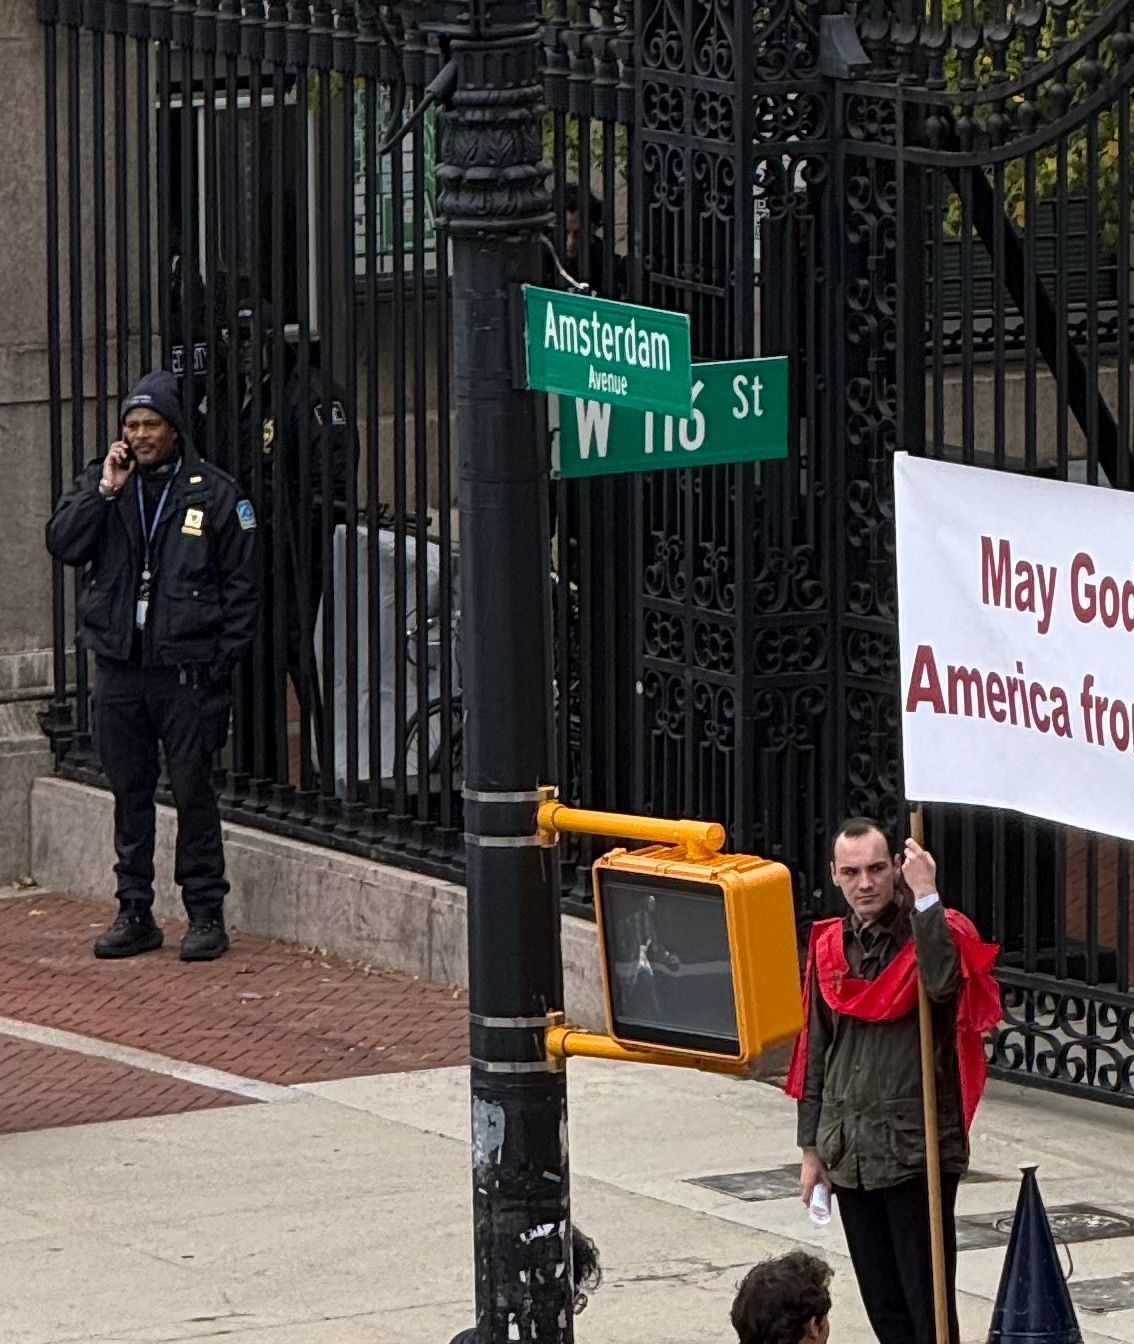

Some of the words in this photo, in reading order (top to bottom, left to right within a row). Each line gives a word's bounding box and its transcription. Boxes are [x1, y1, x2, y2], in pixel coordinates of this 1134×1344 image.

[544, 301, 671, 371] Amsterdam
[575, 397, 611, 460] W
[644, 380, 706, 454] 116
[732, 374, 764, 419] St
[588, 364, 628, 396] Avenue
[980, 536, 1057, 635] May
[906, 645, 1073, 739] America
